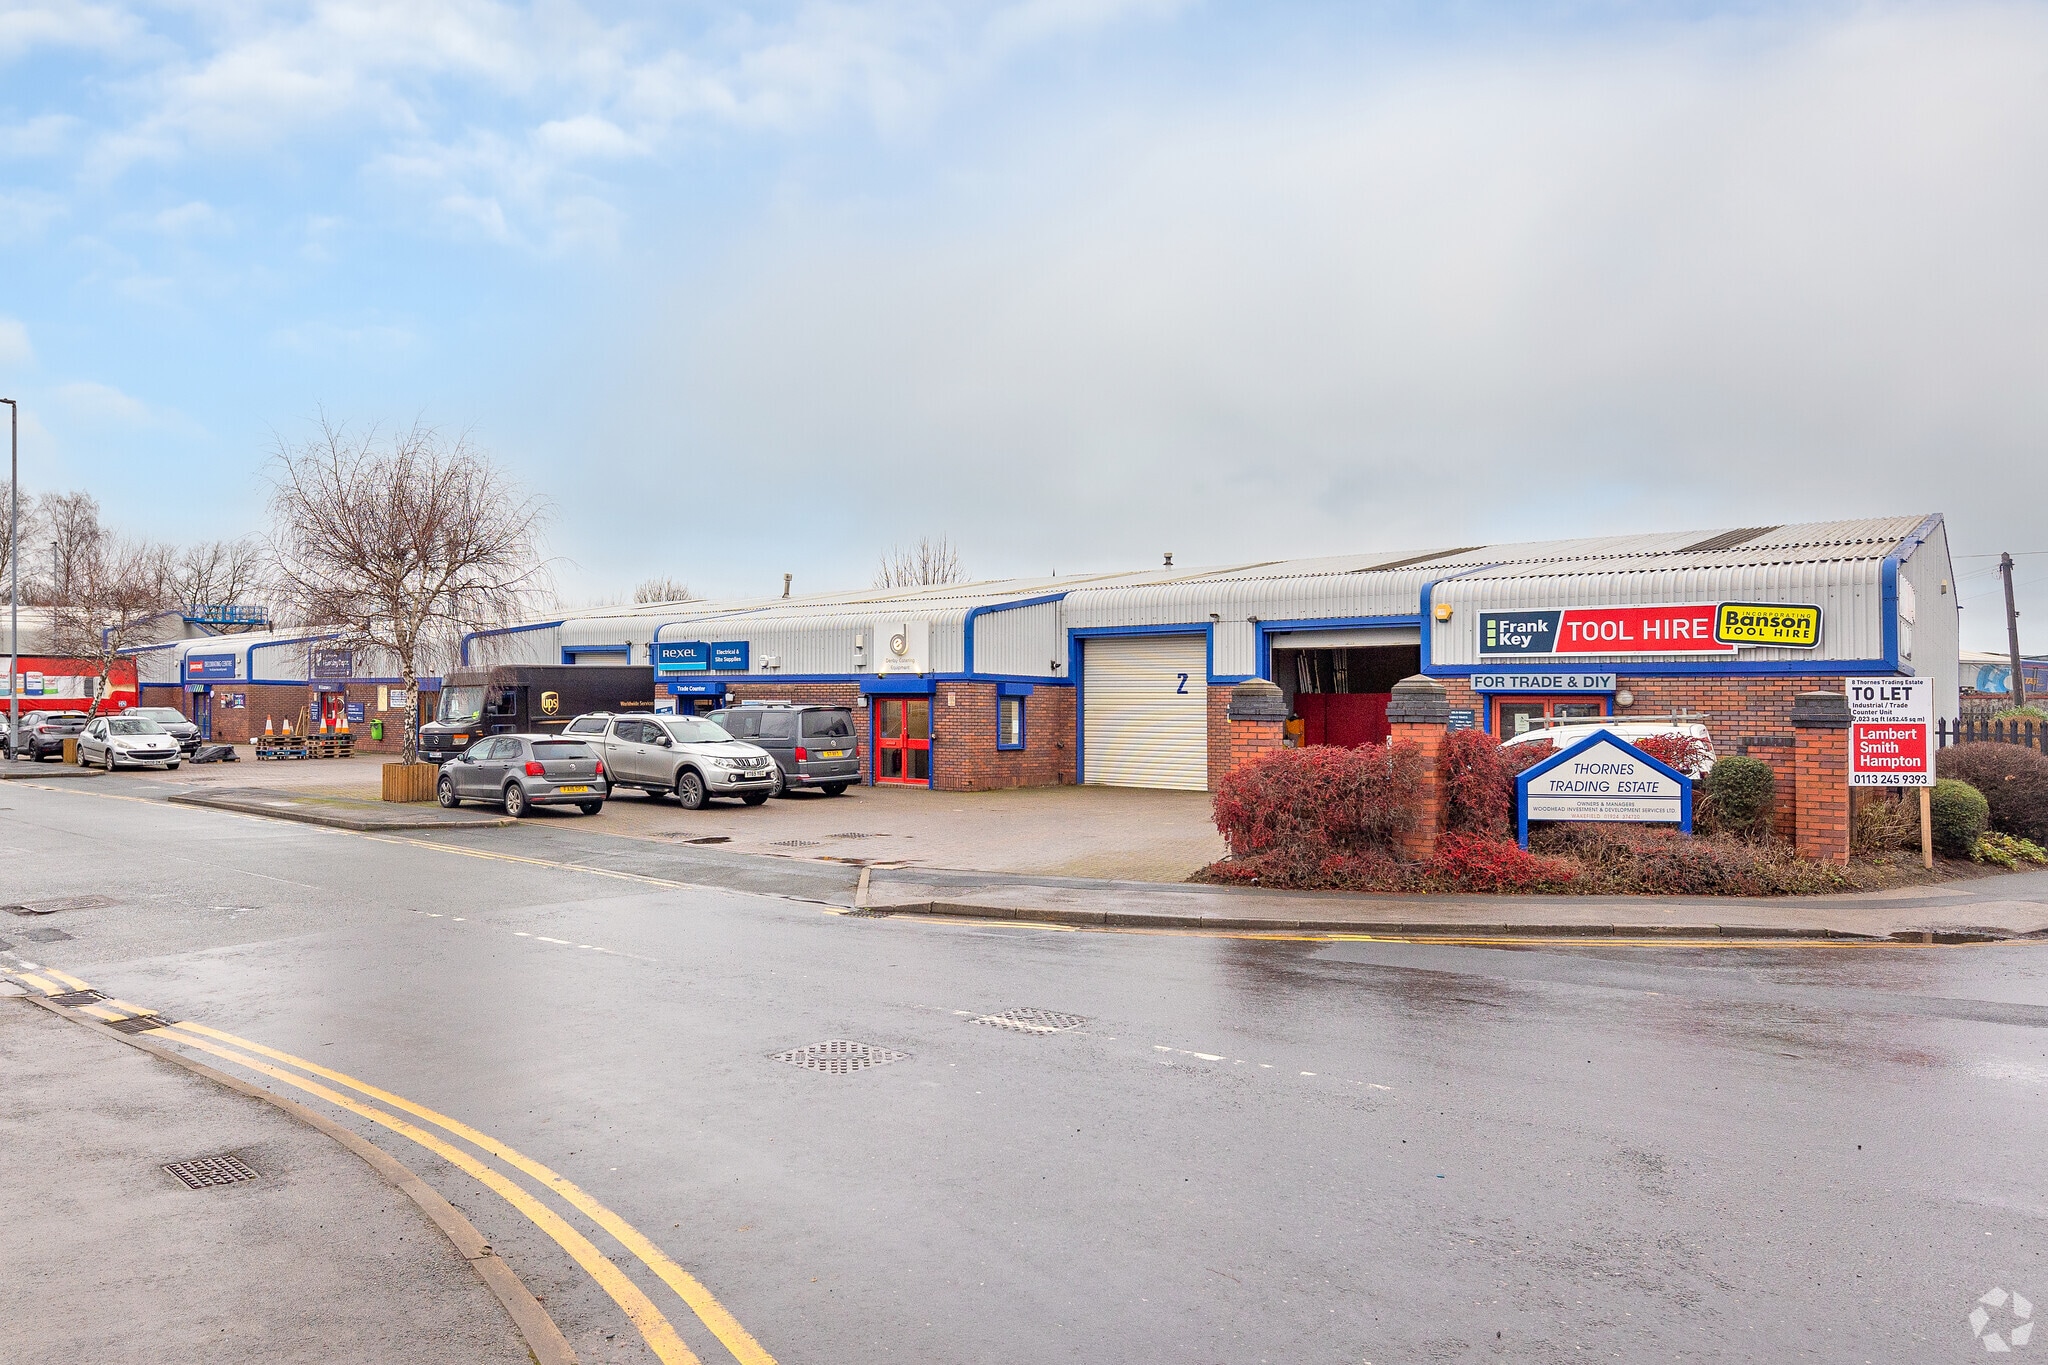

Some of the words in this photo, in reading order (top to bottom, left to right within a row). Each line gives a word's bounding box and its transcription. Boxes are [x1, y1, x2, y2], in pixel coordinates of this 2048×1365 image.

[1726, 610, 1811, 628] Banson
[1499, 620, 1549, 633] Frank
[1566, 620, 1634, 642] TOOL
[1643, 618, 1709, 640] HIRE
[1726, 626, 1765, 636] TOOL
[1774, 628, 1810, 638] HIRE
[1500, 633, 1532, 648] Key
[1177, 673, 1188, 694] 2
[1474, 676, 1505, 688] FOR
[1510, 676, 1562, 688] TRADE
[1568, 676, 1578, 688] &
[1583, 676, 1611, 688] DIY
[1852, 687, 1874, 700] TO
[1880, 687, 1912, 700] LET
[544, 698, 557, 711] ups
[1860, 728, 1917, 739] Lambert
[1860, 741, 1899, 753] Smith
[1860, 755, 1921, 769] Hampton
[1574, 763, 1634, 775] THORNES
[1854, 774, 1878, 784] 0113
[1881, 774, 1899, 784] 245
[1902, 775, 1927, 784] 9393
[1550, 780, 1610, 792] TRADING
[1617, 781, 1659, 793] ESTATE
